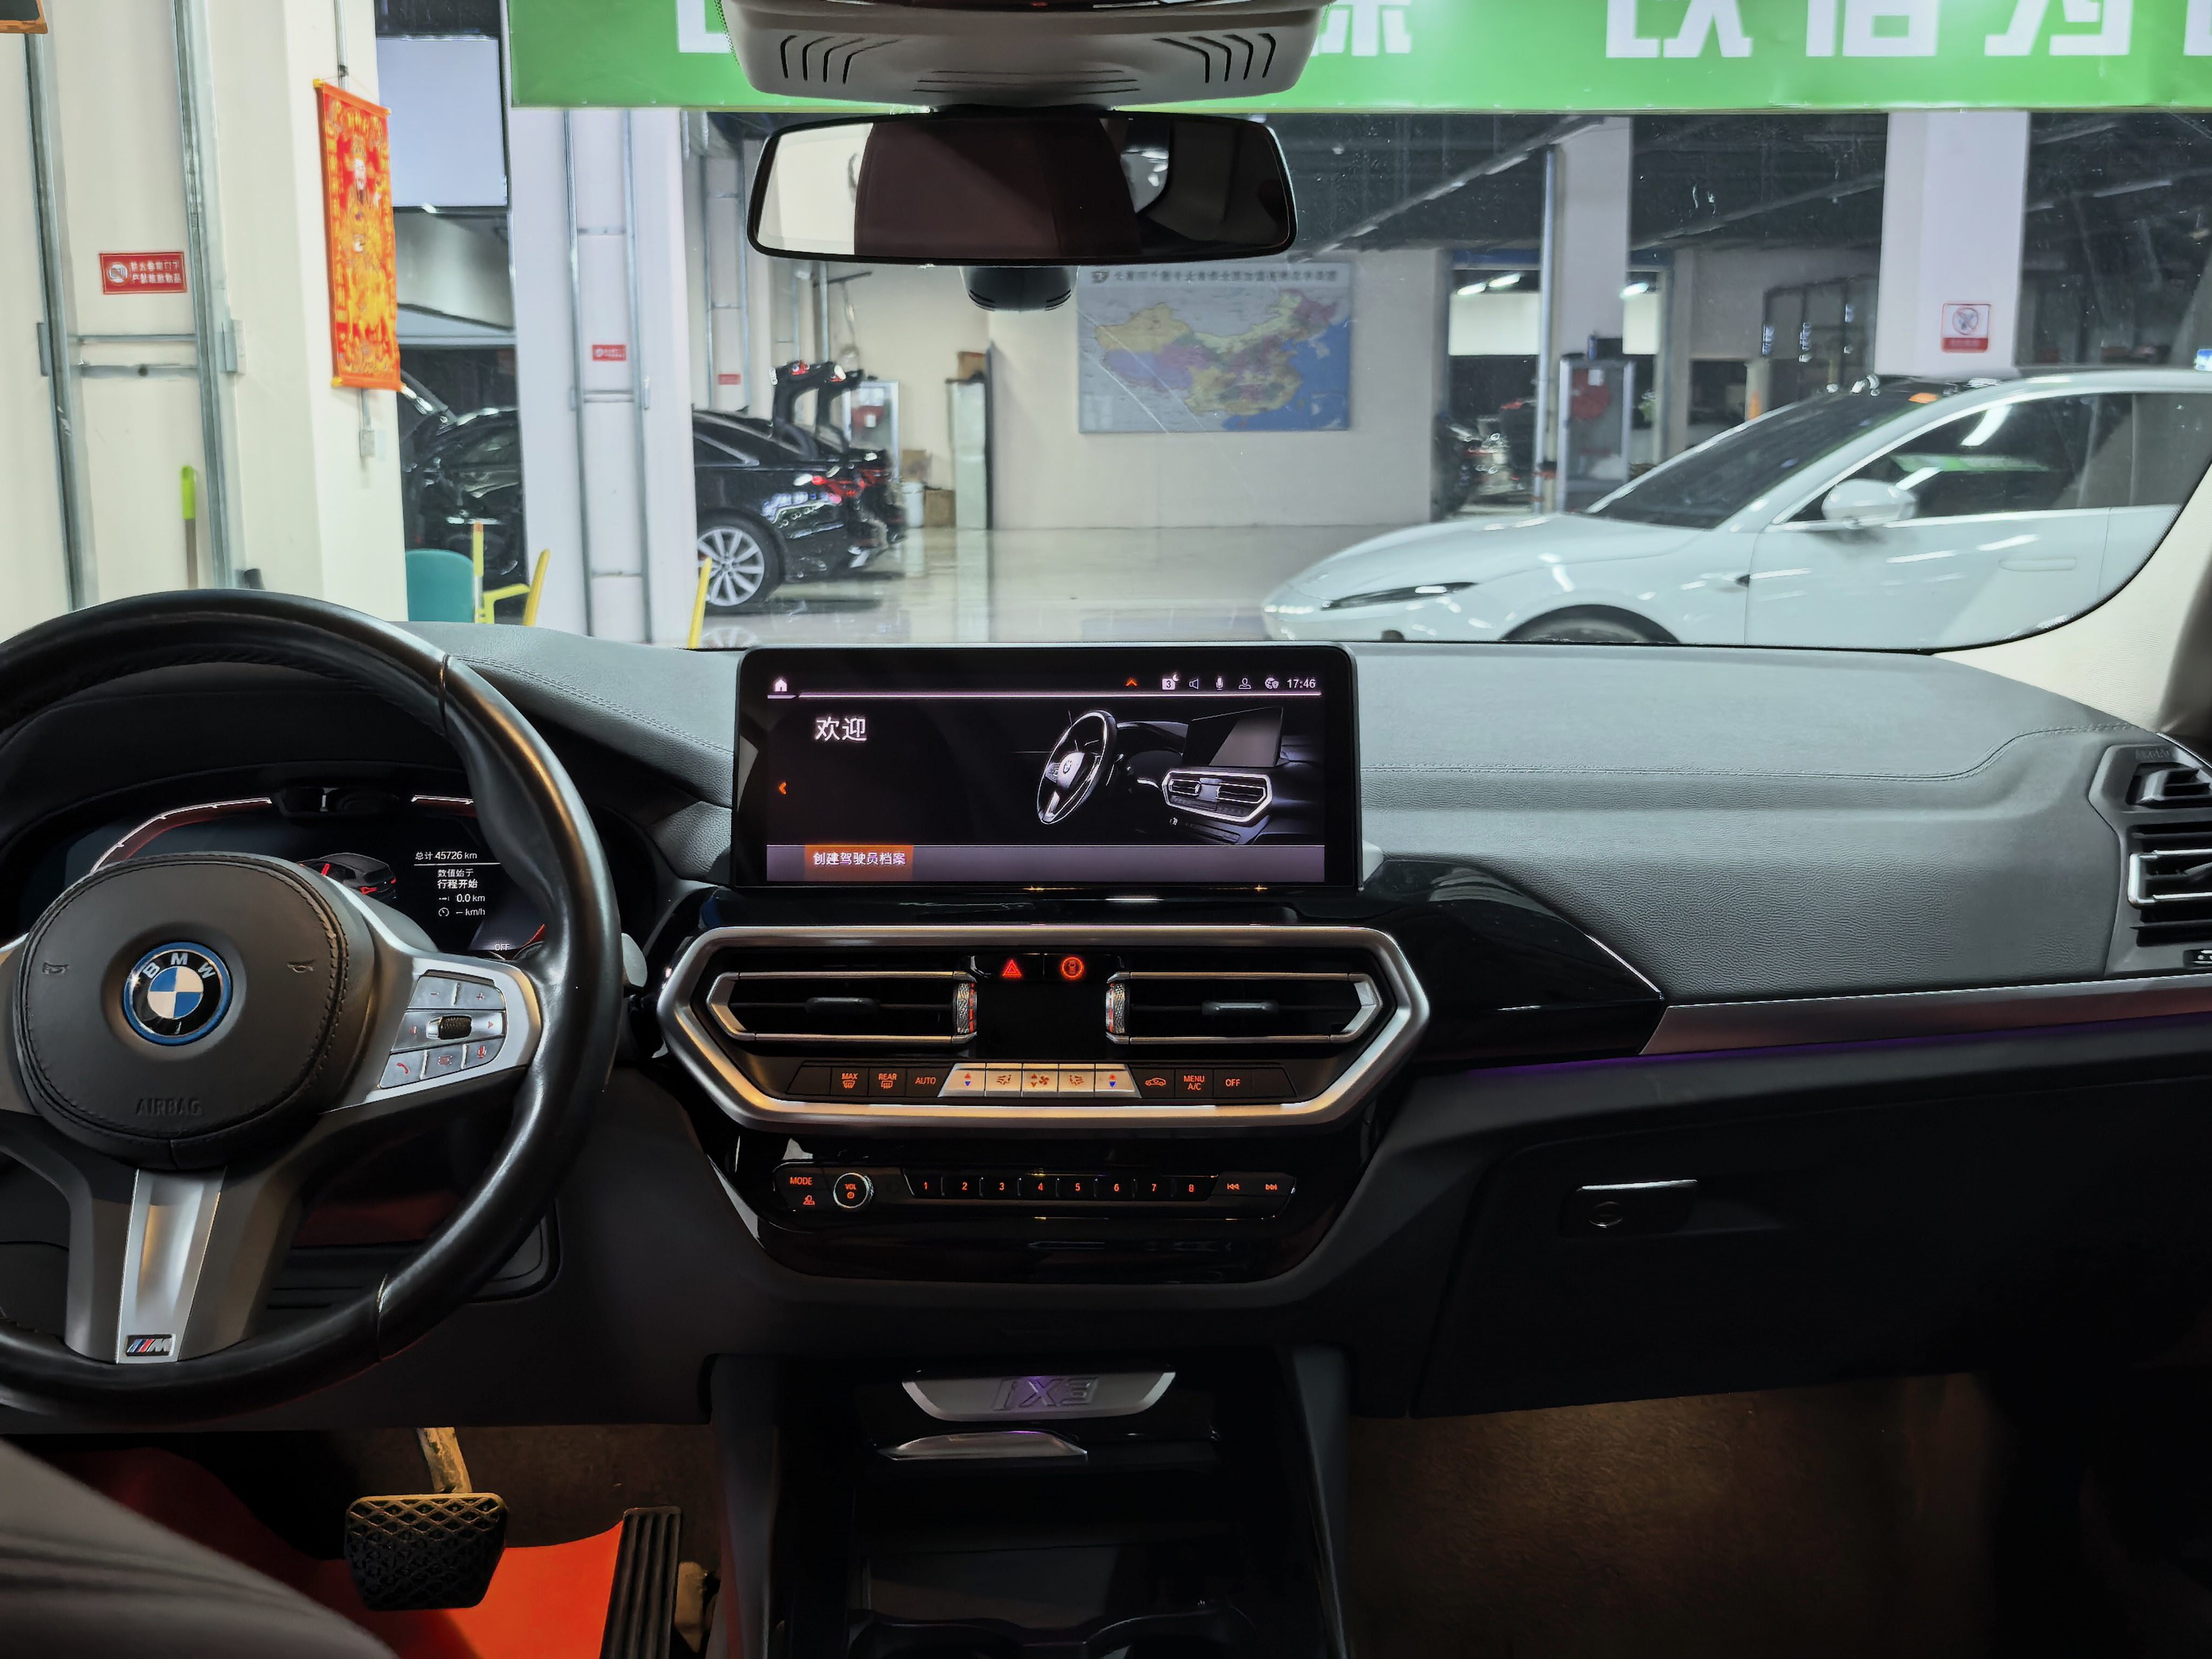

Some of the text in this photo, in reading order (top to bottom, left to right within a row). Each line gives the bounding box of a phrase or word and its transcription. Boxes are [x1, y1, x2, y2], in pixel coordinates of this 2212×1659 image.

[1287, 678, 1316, 689] 17:46
[815, 716, 867, 741] 欢迎
[415, 851, 433, 860] 总计
[435, 851, 463, 860] 45726
[813, 852, 906, 865] 创建驾驶员档案
[437, 868, 474, 878] 数值始于
[437, 878, 478, 889] 行程开始
[456, 893, 471, 902] 0.0
[465, 907, 485, 916] km/h
[494, 943, 510, 951] OFF
[143, 952, 216, 979] BMW
[915, 1077, 936, 1085] AUTO
[1183, 1075, 1205, 1083] MENU
[1225, 1078, 1240, 1087] OFF
[1188, 1082, 1204, 1091] A/C
[136, 1097, 202, 1115] AIRBAG
[790, 1177, 813, 1185] MODE
[923, 1182, 928, 1190] 1
[962, 1182, 968, 1190] 2
[999, 1183, 1005, 1191] 3
[1075, 1183, 1081, 1191] 5
[1114, 1183, 1120, 1192] 6
[1151, 1183, 1157, 1191] 7
[1189, 1184, 1195, 1192] 8
